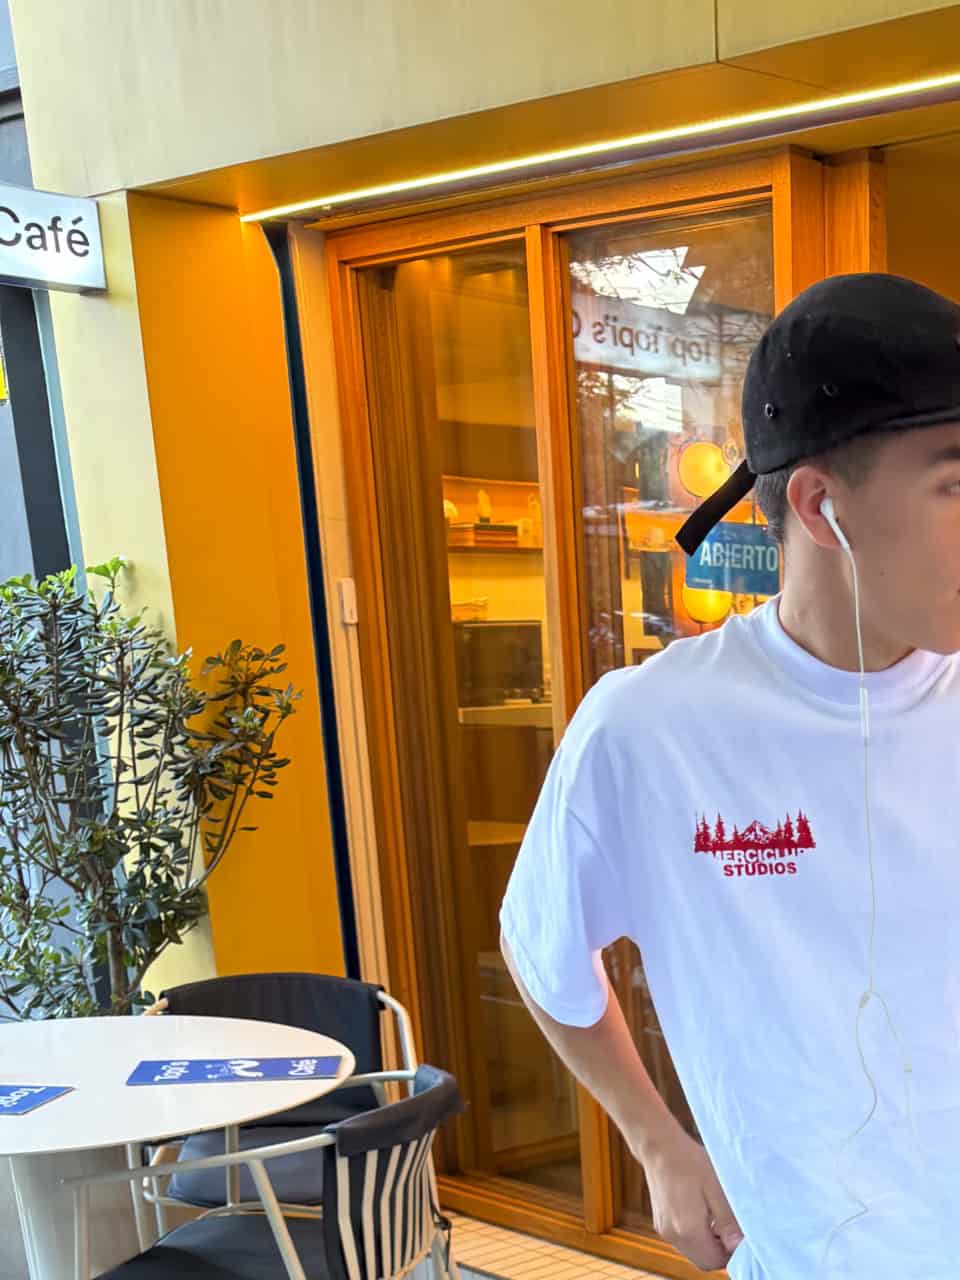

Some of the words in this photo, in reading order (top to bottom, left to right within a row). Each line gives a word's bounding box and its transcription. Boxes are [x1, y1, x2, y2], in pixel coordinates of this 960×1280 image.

[0, 206, 90, 257] Café
[699, 540, 779, 572] ABIERTO
[723, 862, 798, 877] STUDIOS
